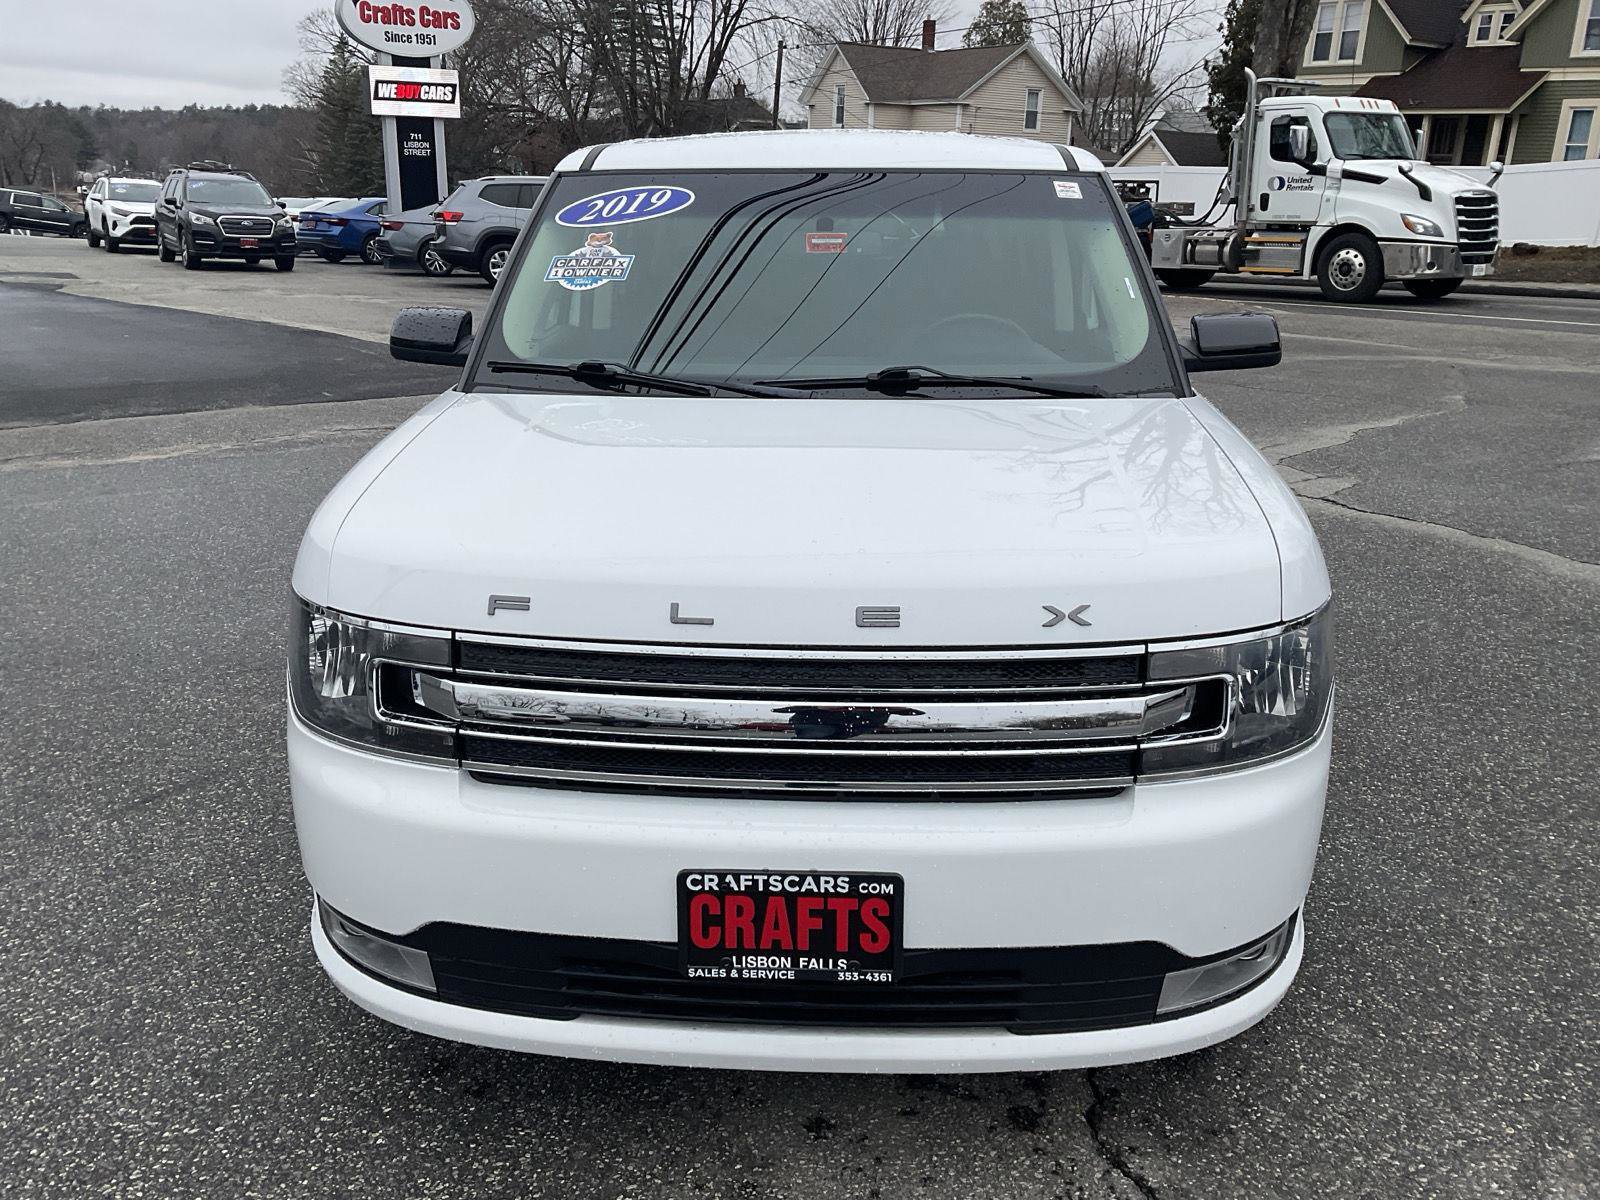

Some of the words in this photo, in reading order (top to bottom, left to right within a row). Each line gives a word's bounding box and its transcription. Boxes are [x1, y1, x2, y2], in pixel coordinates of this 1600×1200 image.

[359, 0, 415, 26] Crafts
[419, 5, 461, 30] Cars
[384, 31, 413, 43] Since
[415, 33, 436, 45] 1951
[1287, 176, 1313, 184] United
[577, 189, 672, 223] 2019
[556, 259, 627, 268] CARFAX
[564, 268, 623, 277] OWNER
[690, 894, 891, 954] CRAFTS
[732, 956, 791, 969] LISBON
[799, 957, 848, 970] FALLS
[688, 968, 727, 977] SALES
[731, 969, 739, 978] &
[742, 969, 795, 979] SERVICE
[837, 971, 892, 982] 353-4361
